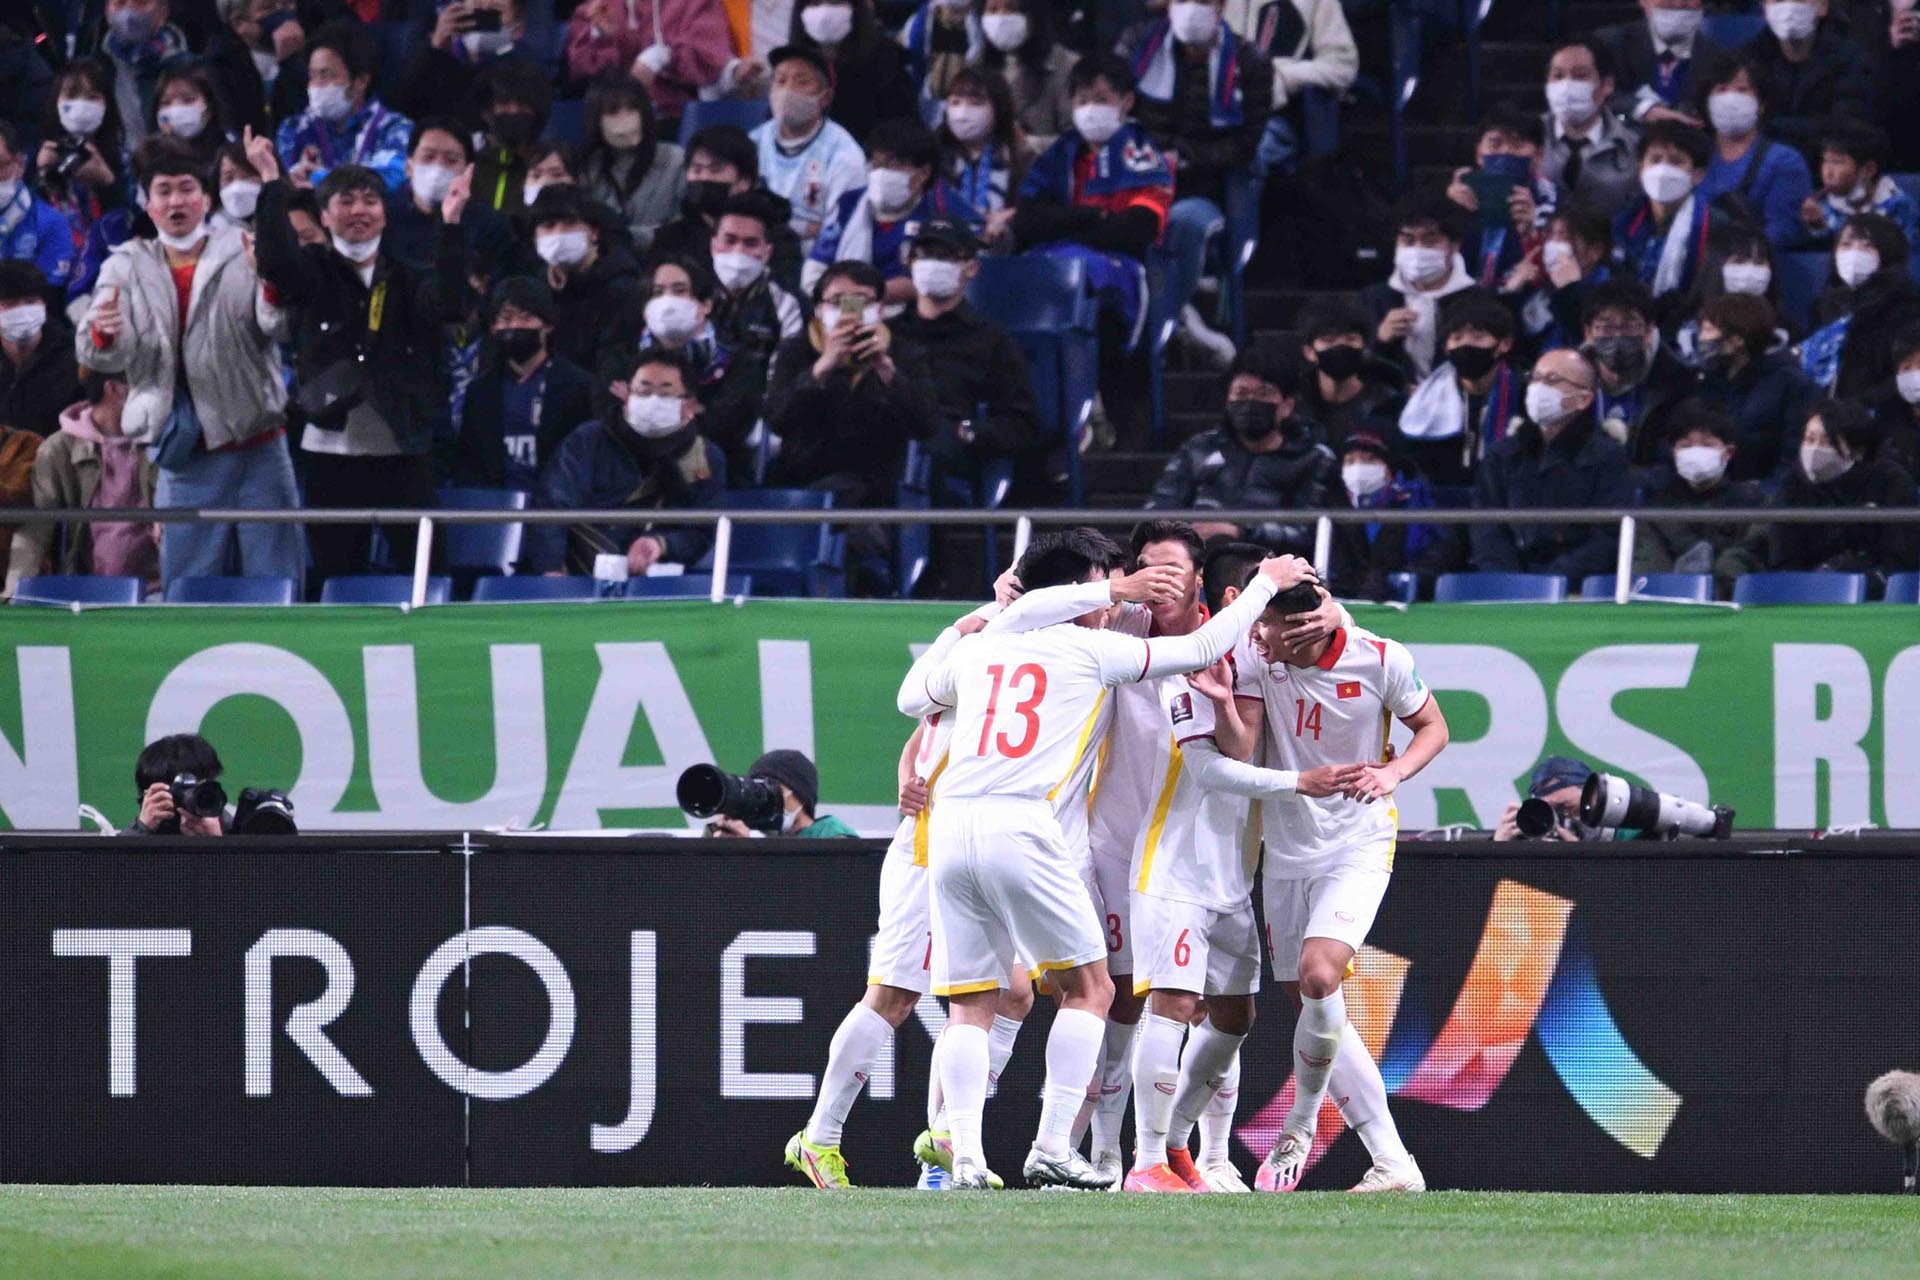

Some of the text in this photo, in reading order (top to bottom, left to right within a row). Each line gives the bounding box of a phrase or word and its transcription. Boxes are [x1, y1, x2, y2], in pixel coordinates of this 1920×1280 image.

[977, 663, 1047, 759] 13
[1296, 699, 1322, 741] 14
[1174, 928, 1191, 967] 6
